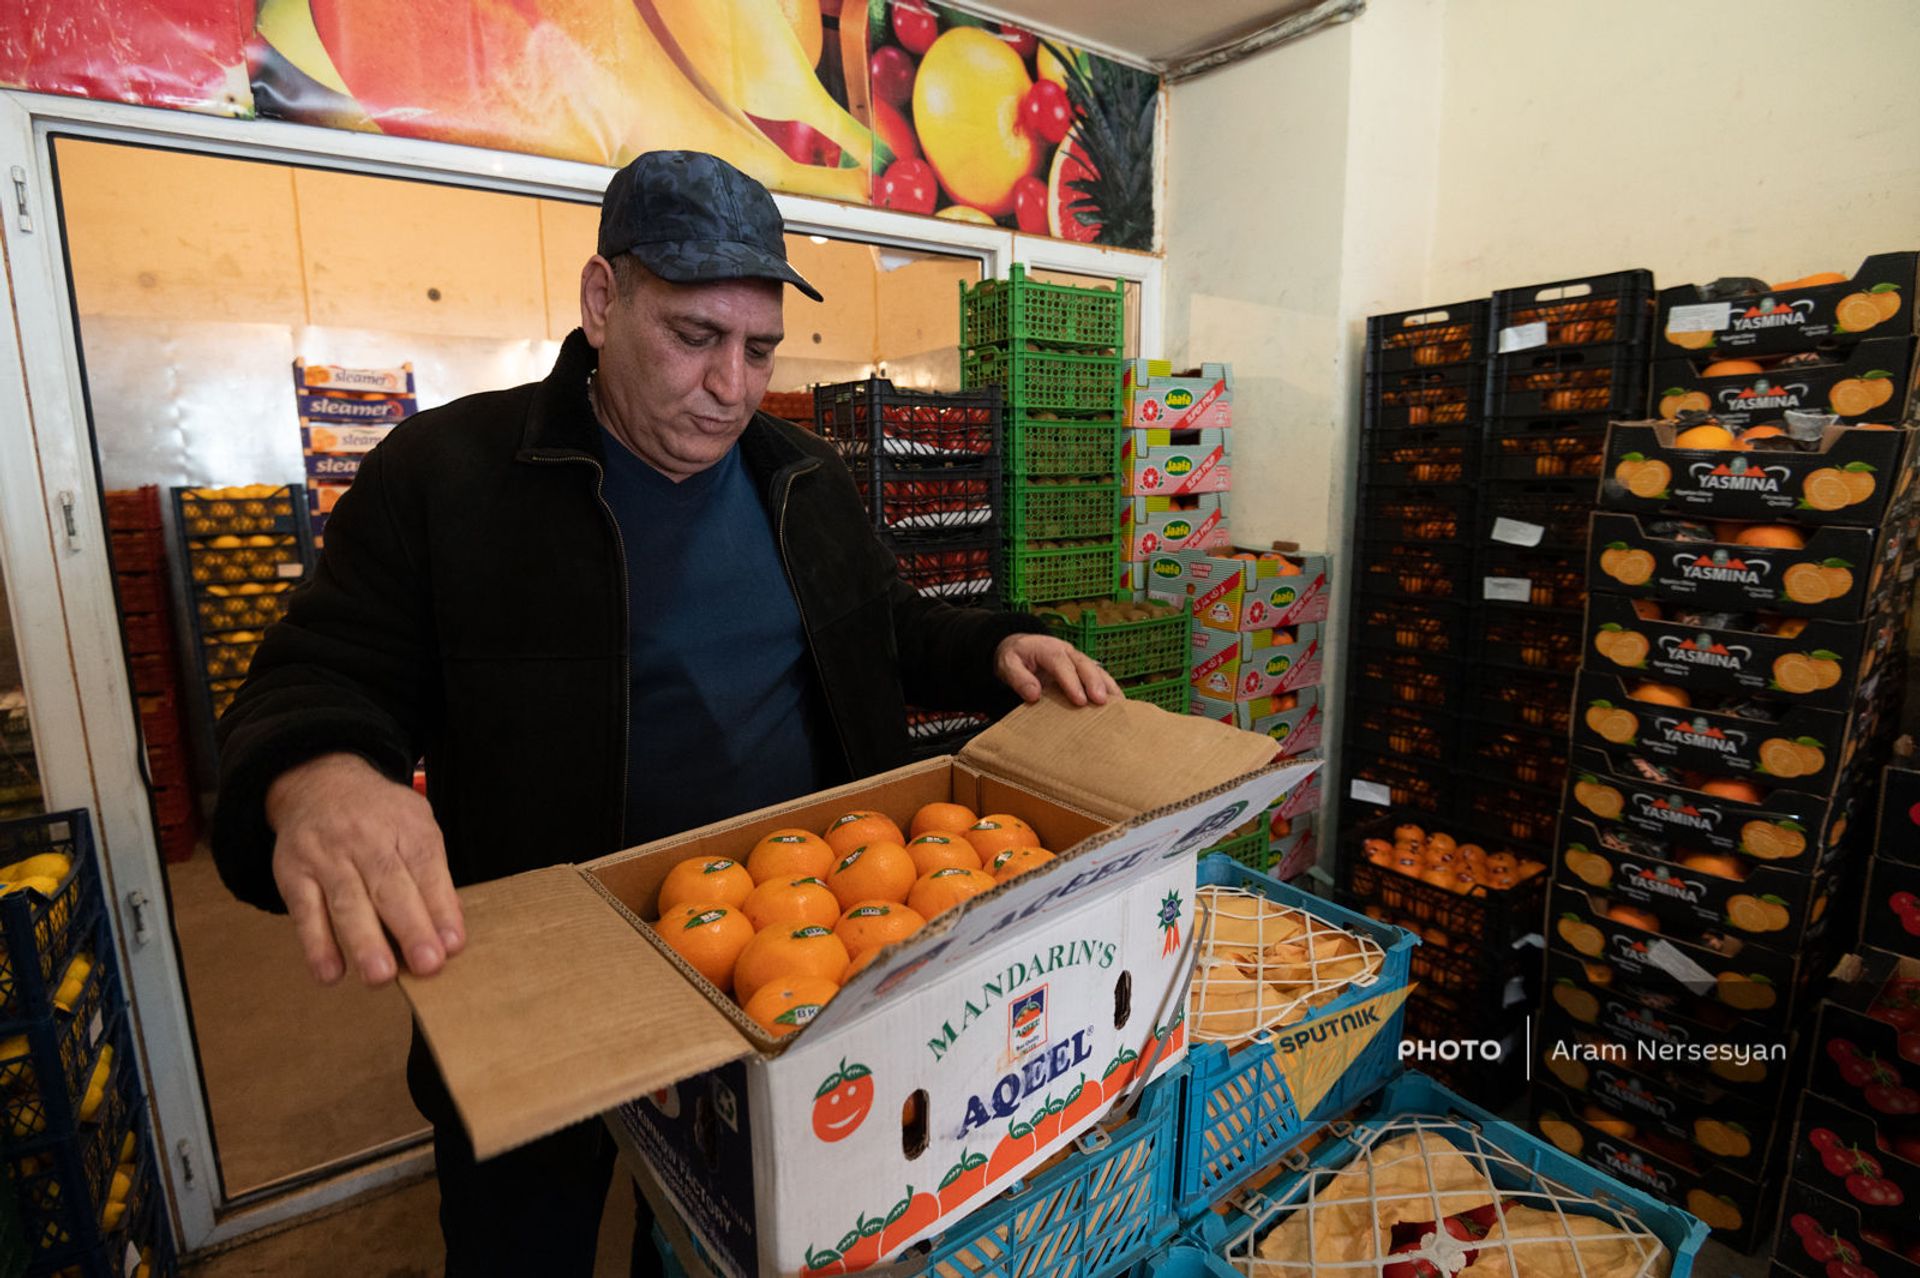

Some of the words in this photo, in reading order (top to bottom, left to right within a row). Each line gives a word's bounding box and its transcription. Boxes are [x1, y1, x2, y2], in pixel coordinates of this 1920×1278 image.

[1732, 312, 1805, 331] YASMINA
[1727, 394, 1799, 411] YASMINA
[1698, 475, 1778, 492] YASMINA
[1682, 565, 1760, 584] YASMINA
[1667, 648, 1740, 669] YASMINA
[1663, 727, 1737, 753] YASMINA
[1640, 804, 1713, 832] YASMINA
[1629, 872, 1698, 903] YASMINA
[927, 939, 1116, 1062] MANDARIN'S
[797, 1007, 817, 1018] BK
[957, 1029, 1092, 1140] AQEEL
[1605, 1152, 1668, 1193] YASMINA
